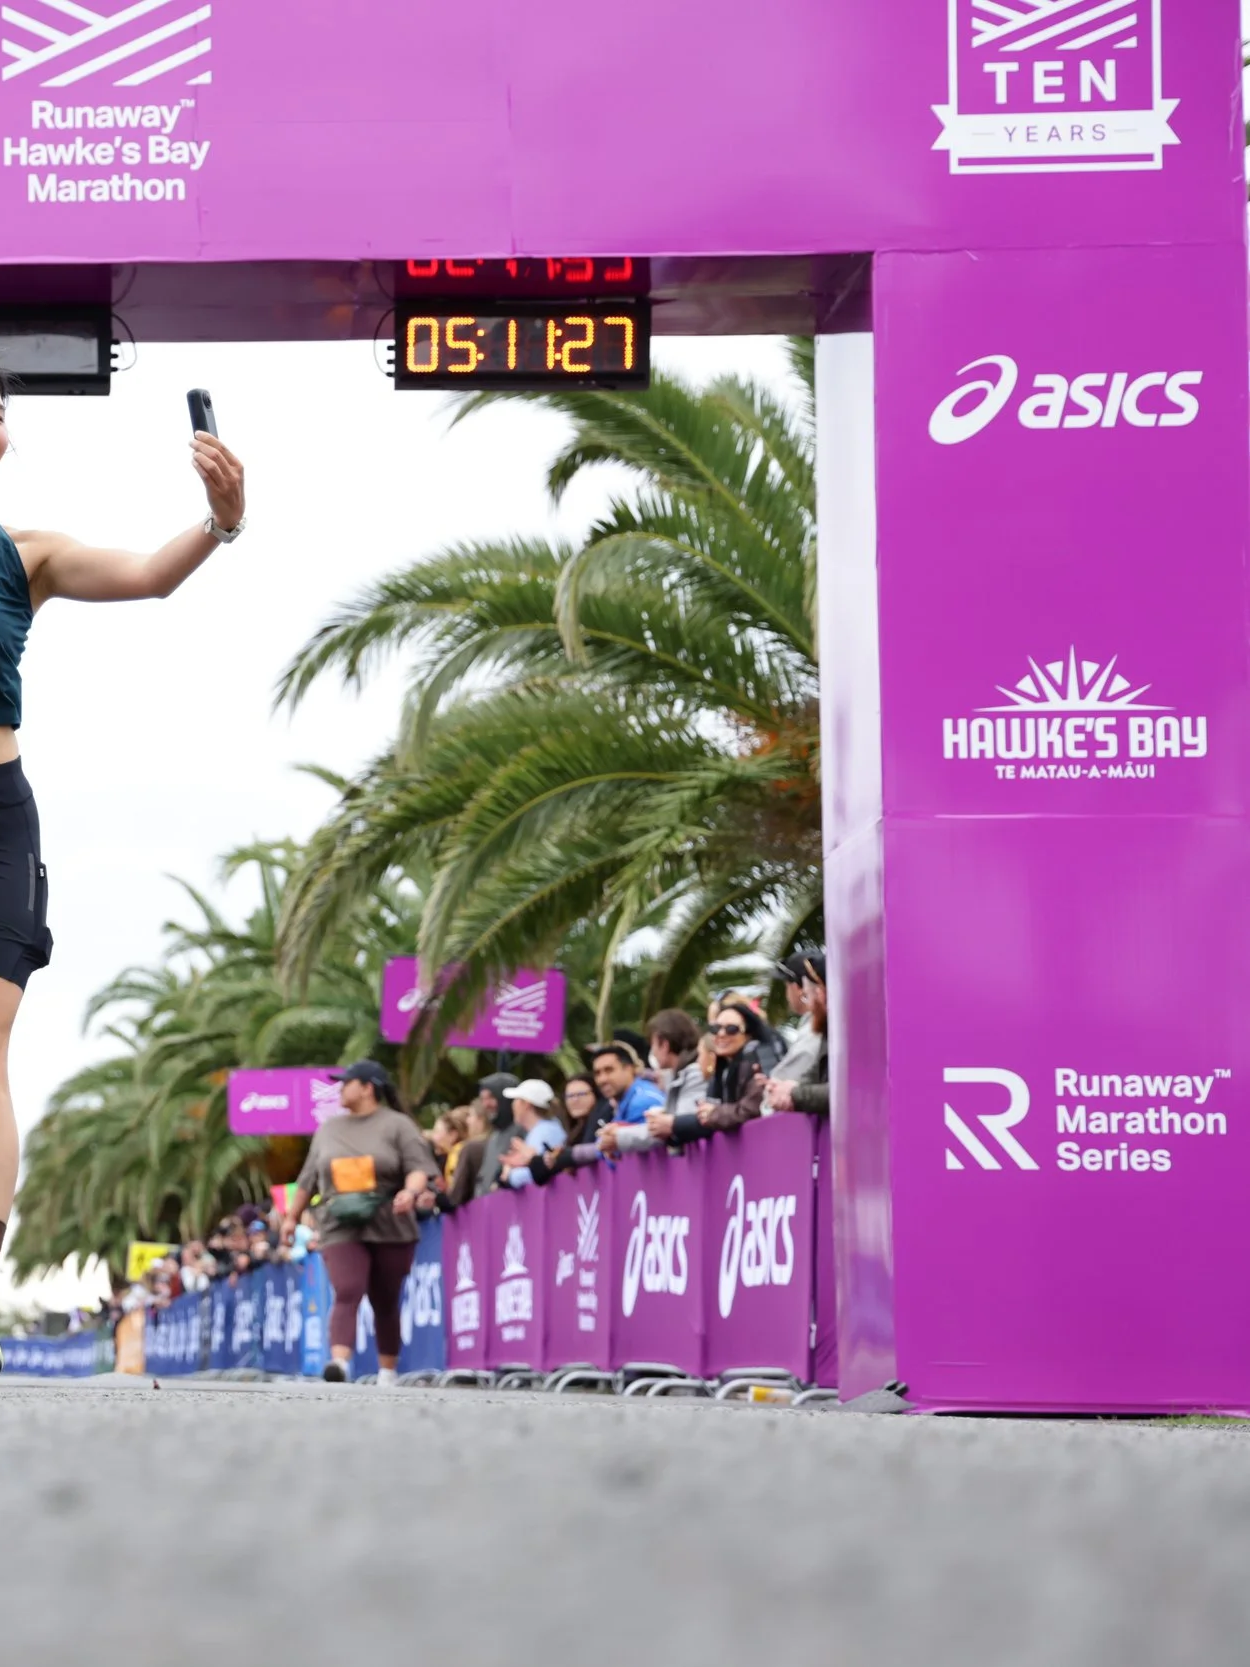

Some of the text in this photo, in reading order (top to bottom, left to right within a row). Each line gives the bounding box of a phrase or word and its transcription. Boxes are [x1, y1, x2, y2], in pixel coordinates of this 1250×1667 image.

[983, 59, 1116, 104] TEN
[3, 135, 211, 171] Hawke's Bay
[1004, 123, 1107, 143] YEARS
[27, 172, 186, 203] Marathon
[407, 316, 634, 373] 05:11:27
[1017, 370, 1204, 429] asics
[942, 716, 1208, 760] HAWKE'S BAY
[995, 764, 1016, 780] TE
[1056, 1104, 1228, 1135] Marathon
[1056, 1141, 1173, 1172] Series
[642, 1214, 690, 1295] asics
[740, 1195, 797, 1287] asics
